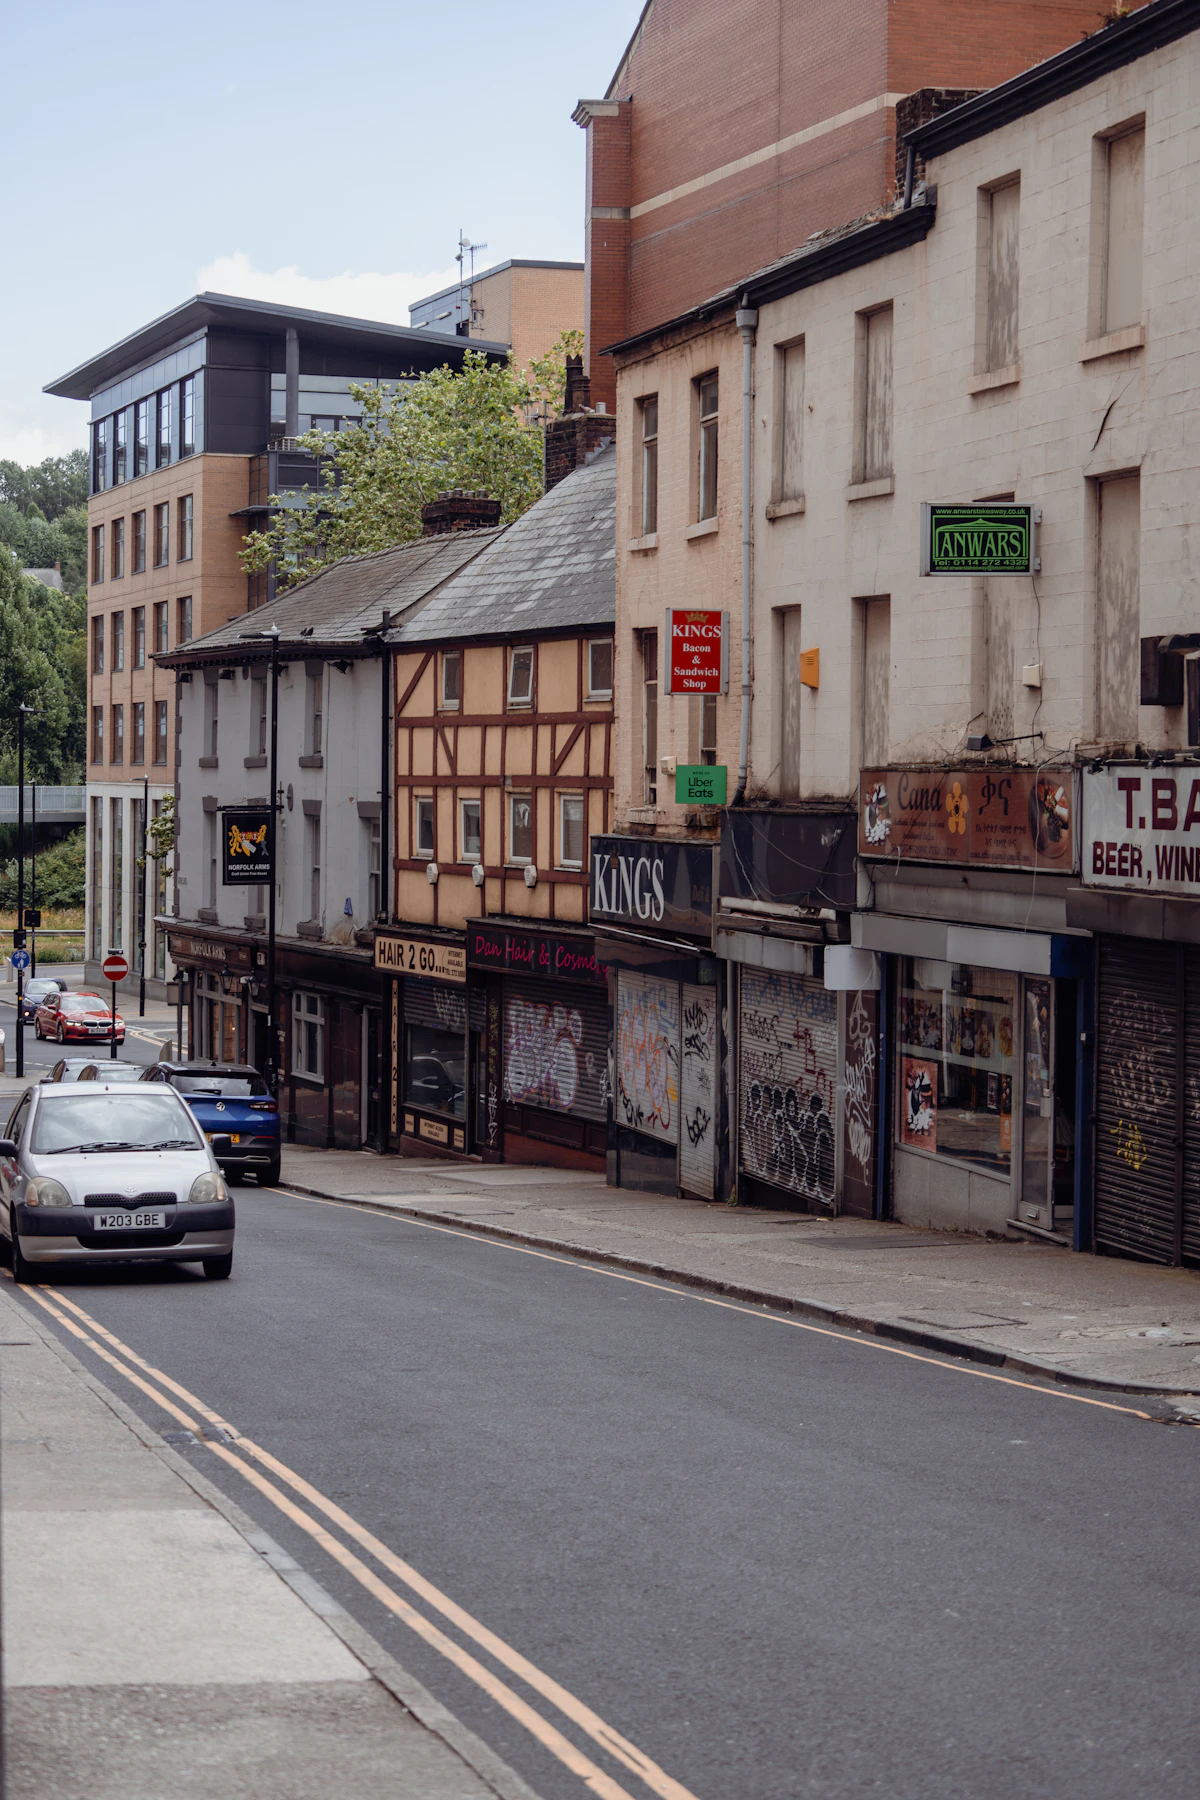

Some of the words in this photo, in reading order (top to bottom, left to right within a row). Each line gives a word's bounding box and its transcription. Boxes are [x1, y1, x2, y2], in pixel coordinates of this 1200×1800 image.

[940, 532, 1021, 557] ANWARS
[672, 625, 721, 637] KINGS
[683, 643, 711, 652] Bacon
[692, 656, 701, 664] &
[674, 667, 719, 676] Sandwich
[683, 679, 707, 689] Shop
[688, 777, 714, 787] Uber
[688, 788, 714, 798] Eats
[898, 772, 942, 811] Cana
[379, 941, 404, 967] HAIR
[409, 944, 415, 970] 2
[475, 936, 502, 956] Dan
[505, 938, 535, 962] Hair
[539, 943, 550, 965] &
[100, 1215, 132, 1227] W203
[135, 1214, 159, 1226] GBE
